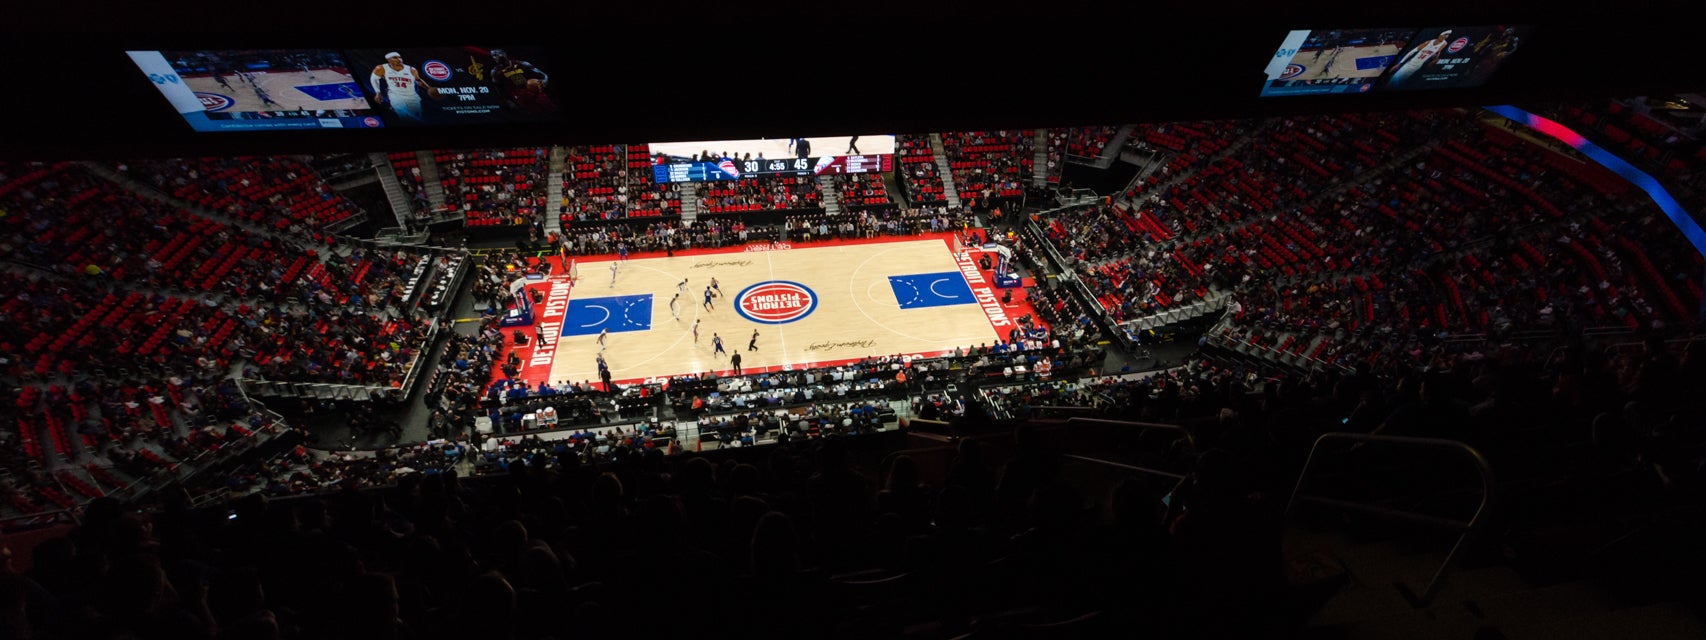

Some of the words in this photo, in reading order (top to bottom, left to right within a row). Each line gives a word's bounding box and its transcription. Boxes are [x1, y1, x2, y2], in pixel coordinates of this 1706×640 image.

[478, 86, 490, 94] 20
[457, 94, 476, 102] 7PM
[744, 161, 758, 173] 30
[769, 162, 785, 171] 4:55
[793, 158, 808, 170] 45
[750, 293, 801, 304] PISTONS
[752, 300, 802, 311] DETROIT
[974, 286, 1011, 327] PISTONS
